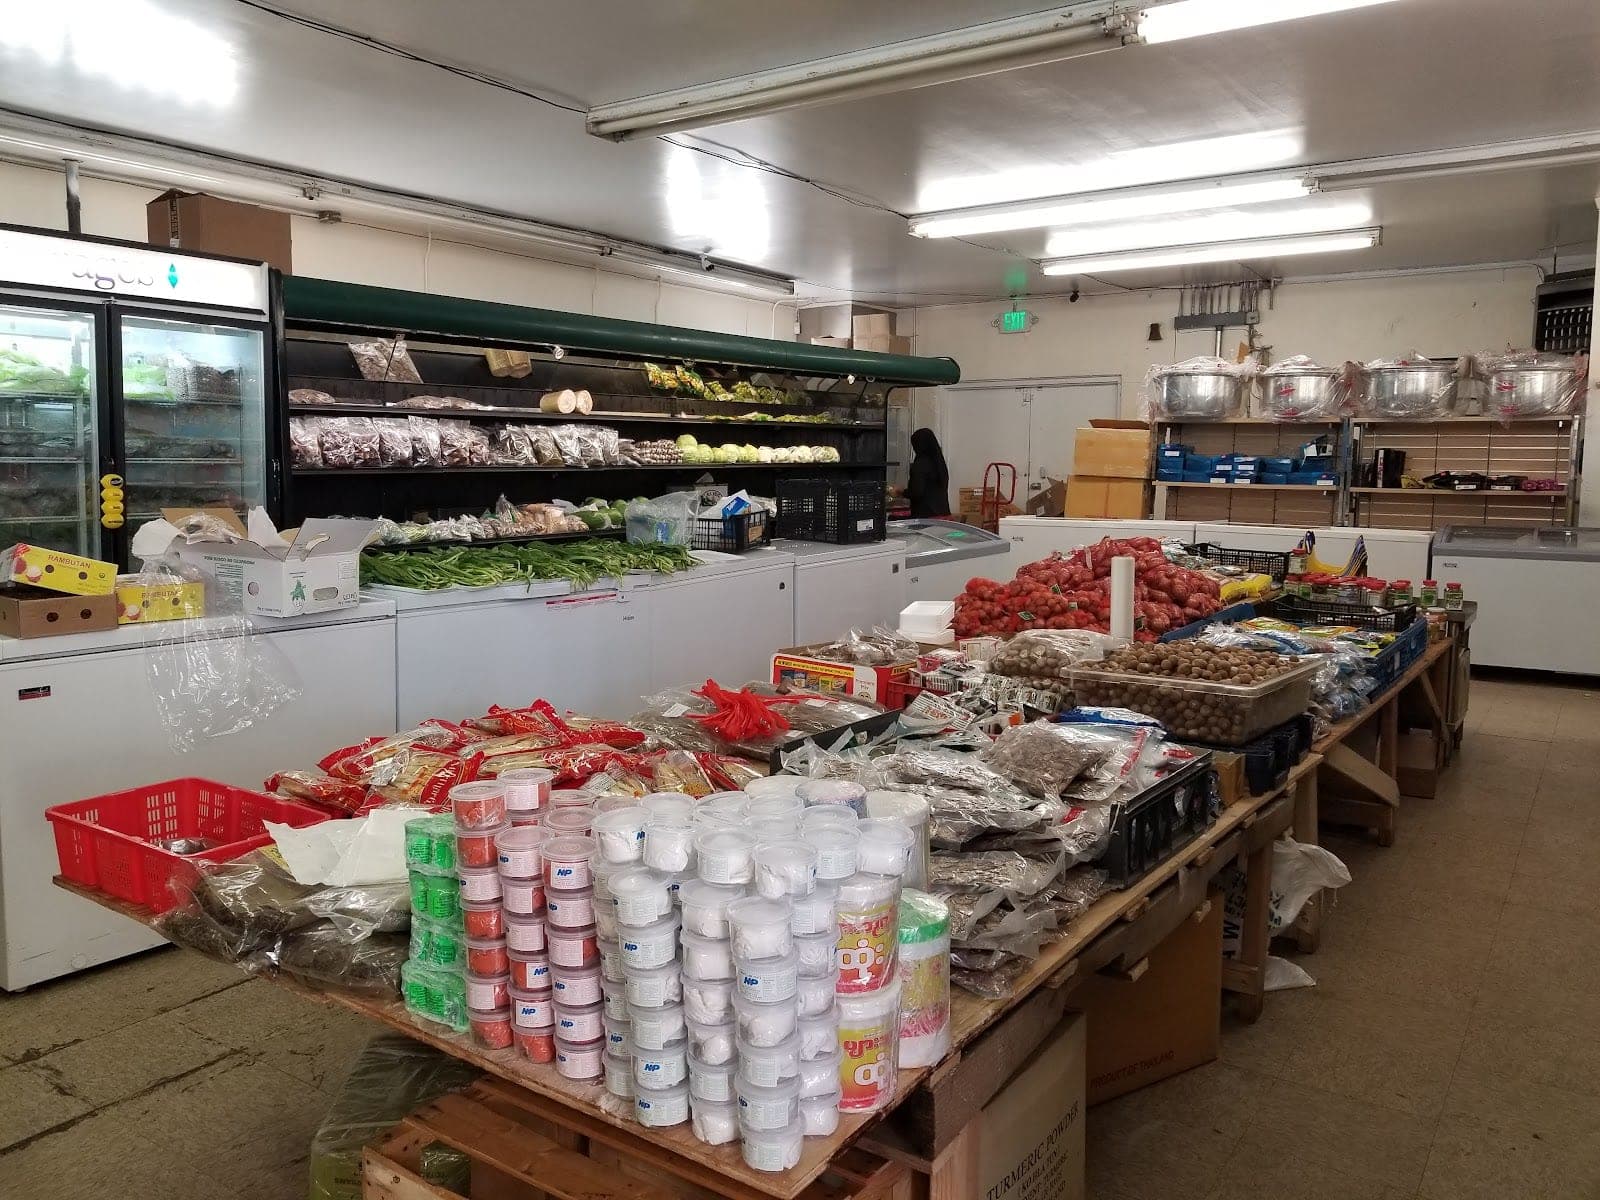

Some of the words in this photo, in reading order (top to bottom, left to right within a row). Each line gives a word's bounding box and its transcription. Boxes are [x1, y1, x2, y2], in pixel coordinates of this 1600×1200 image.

[1004, 312, 1025, 330] EXIT
[47, 554, 91, 569] RAMBUTAN
[557, 869, 572, 877] NP
[624, 943, 638, 951] NP
[744, 977, 759, 986] NP
[561, 1020, 574, 1028] NP
[644, 1064, 660, 1072] NP
[987, 1142, 1044, 1200] TURMERIC
[1046, 1099, 1079, 1152] POWDER
